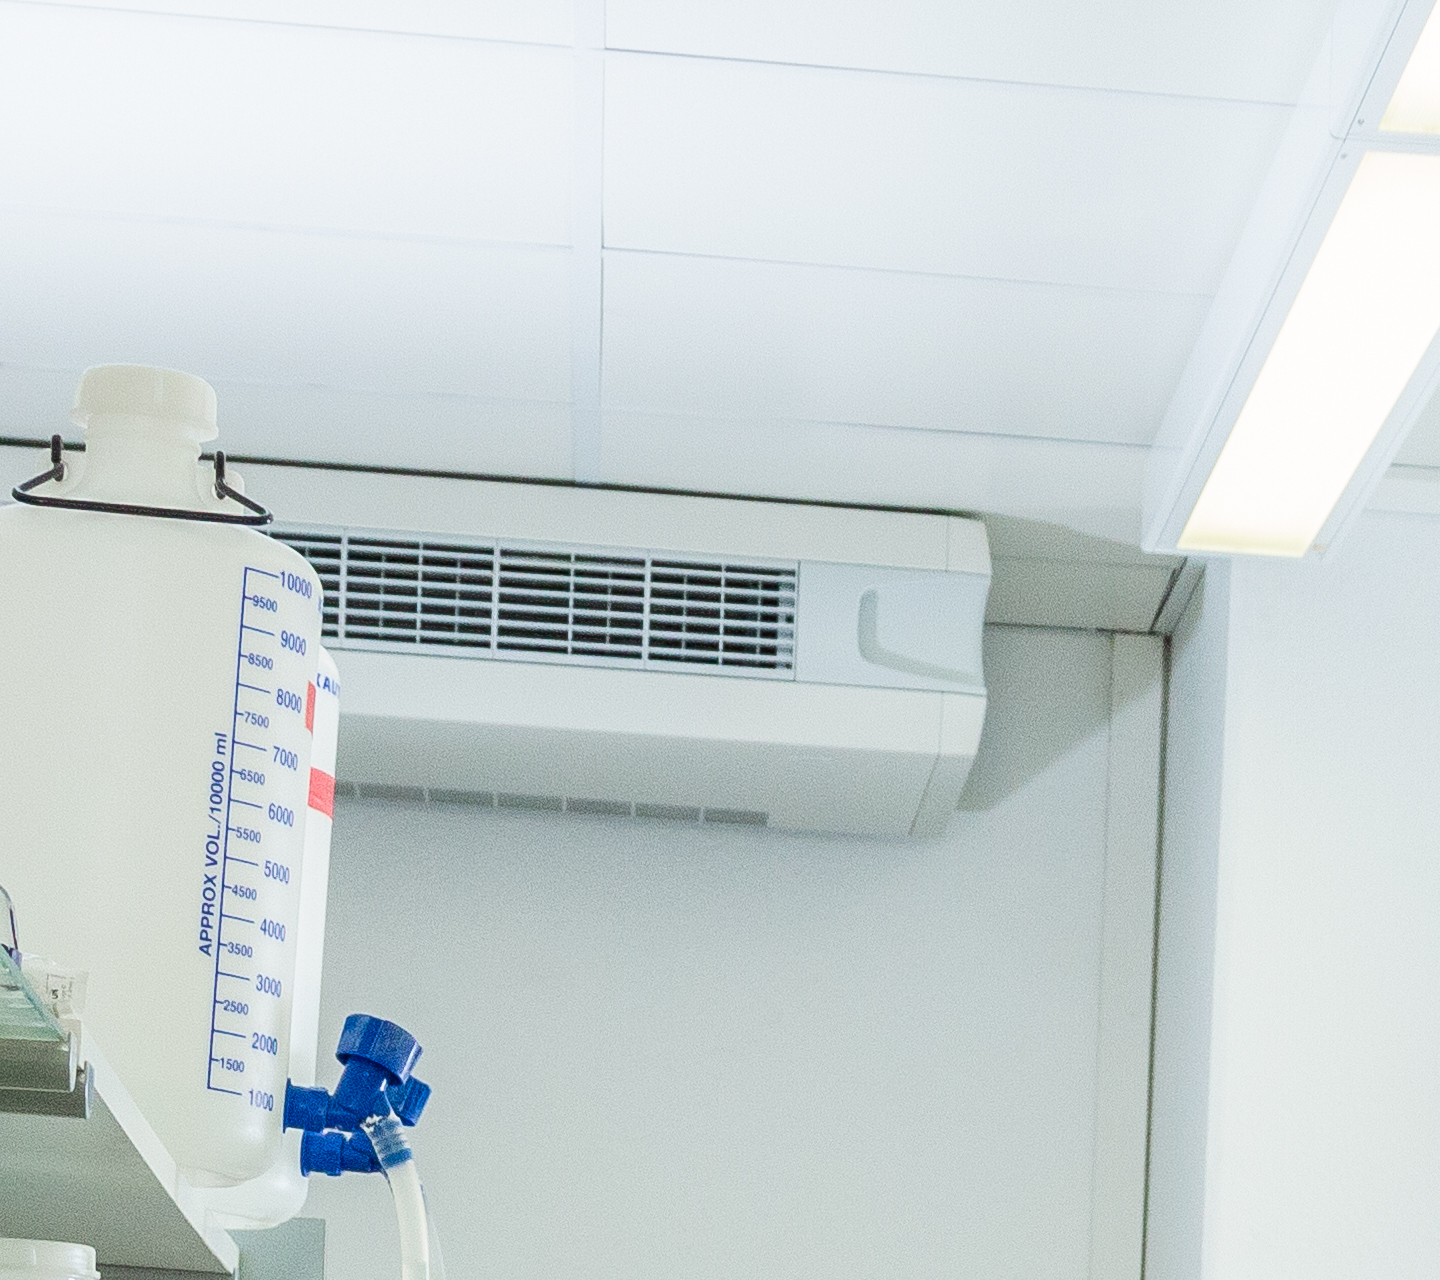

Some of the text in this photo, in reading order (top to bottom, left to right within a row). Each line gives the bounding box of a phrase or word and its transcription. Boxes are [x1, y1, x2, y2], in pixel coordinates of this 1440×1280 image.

[279, 570, 312, 599] 10000
[252, 595, 278, 613] 9500
[280, 630, 307, 656] 9000
[248, 652, 274, 670] 8500
[276, 688, 302, 714] 8000
[244, 711, 270, 729] 7500
[272, 746, 298, 771] 7000
[240, 768, 266, 786] 6500
[268, 802, 294, 828] 6000
[198, 873, 218, 957] APPROX
[214, 732, 228, 756] ml
[236, 826, 262, 844] 5500
[264, 860, 290, 884] 5000
[232, 884, 258, 900] 4500
[260, 918, 286, 942] 4000
[227, 941, 253, 958] 3500
[256, 974, 282, 998] 3000
[223, 999, 249, 1016] 2500
[252, 1032, 278, 1056] 2000
[220, 1056, 245, 1073] 1500
[248, 1088, 274, 1112] 1000
